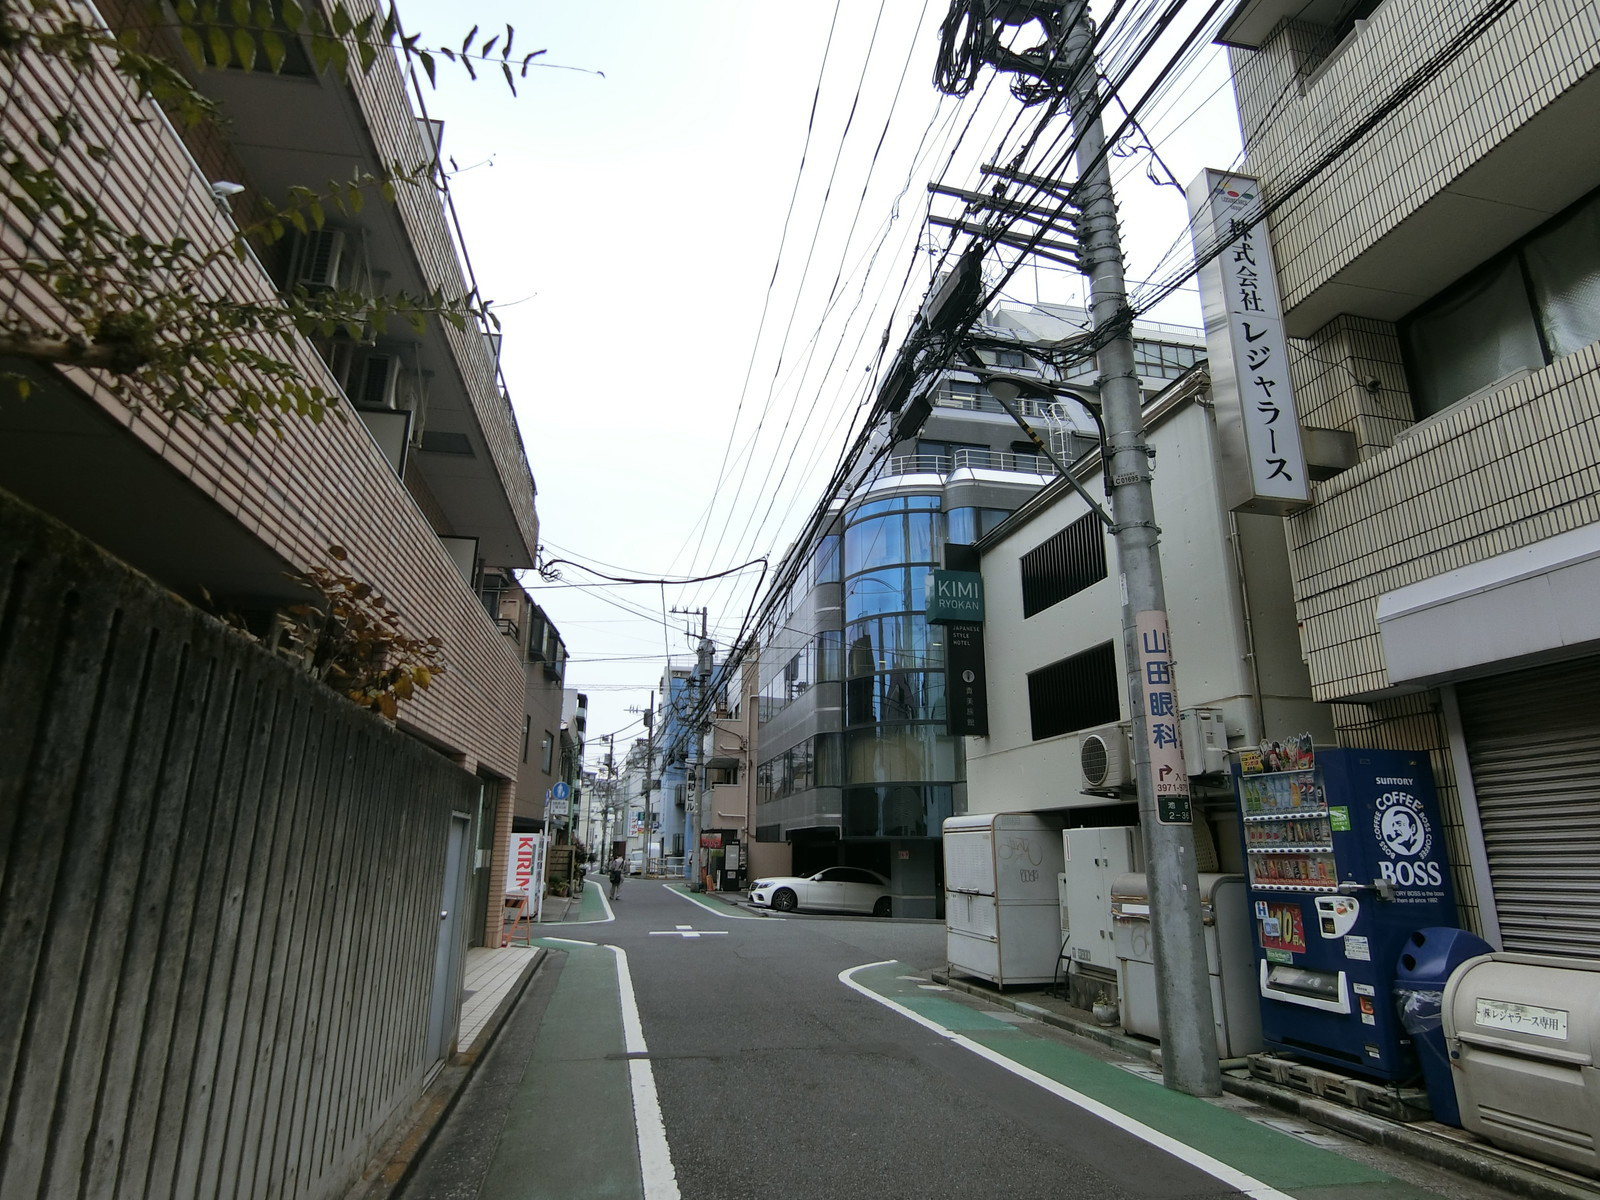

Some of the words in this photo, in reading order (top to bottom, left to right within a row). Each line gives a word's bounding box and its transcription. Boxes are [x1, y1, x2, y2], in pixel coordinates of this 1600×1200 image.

[1115, 475, 1139, 485] C01695
[938, 580, 979, 599] KIMI
[938, 599, 979, 610] RYOKAN
[1142, 629, 1178, 750] 山田眼科
[1375, 777, 1414, 785] SUNTORY
[1375, 791, 1421, 812] COFFEE
[1373, 811, 1382, 840] COFFEE
[1418, 811, 1432, 832] BOSS
[1379, 841, 1396, 860] BOSS
[1419, 835, 1433, 860] COFFEE
[515, 837, 534, 891] KIRIN
[1378, 861, 1442, 886] BOSS
